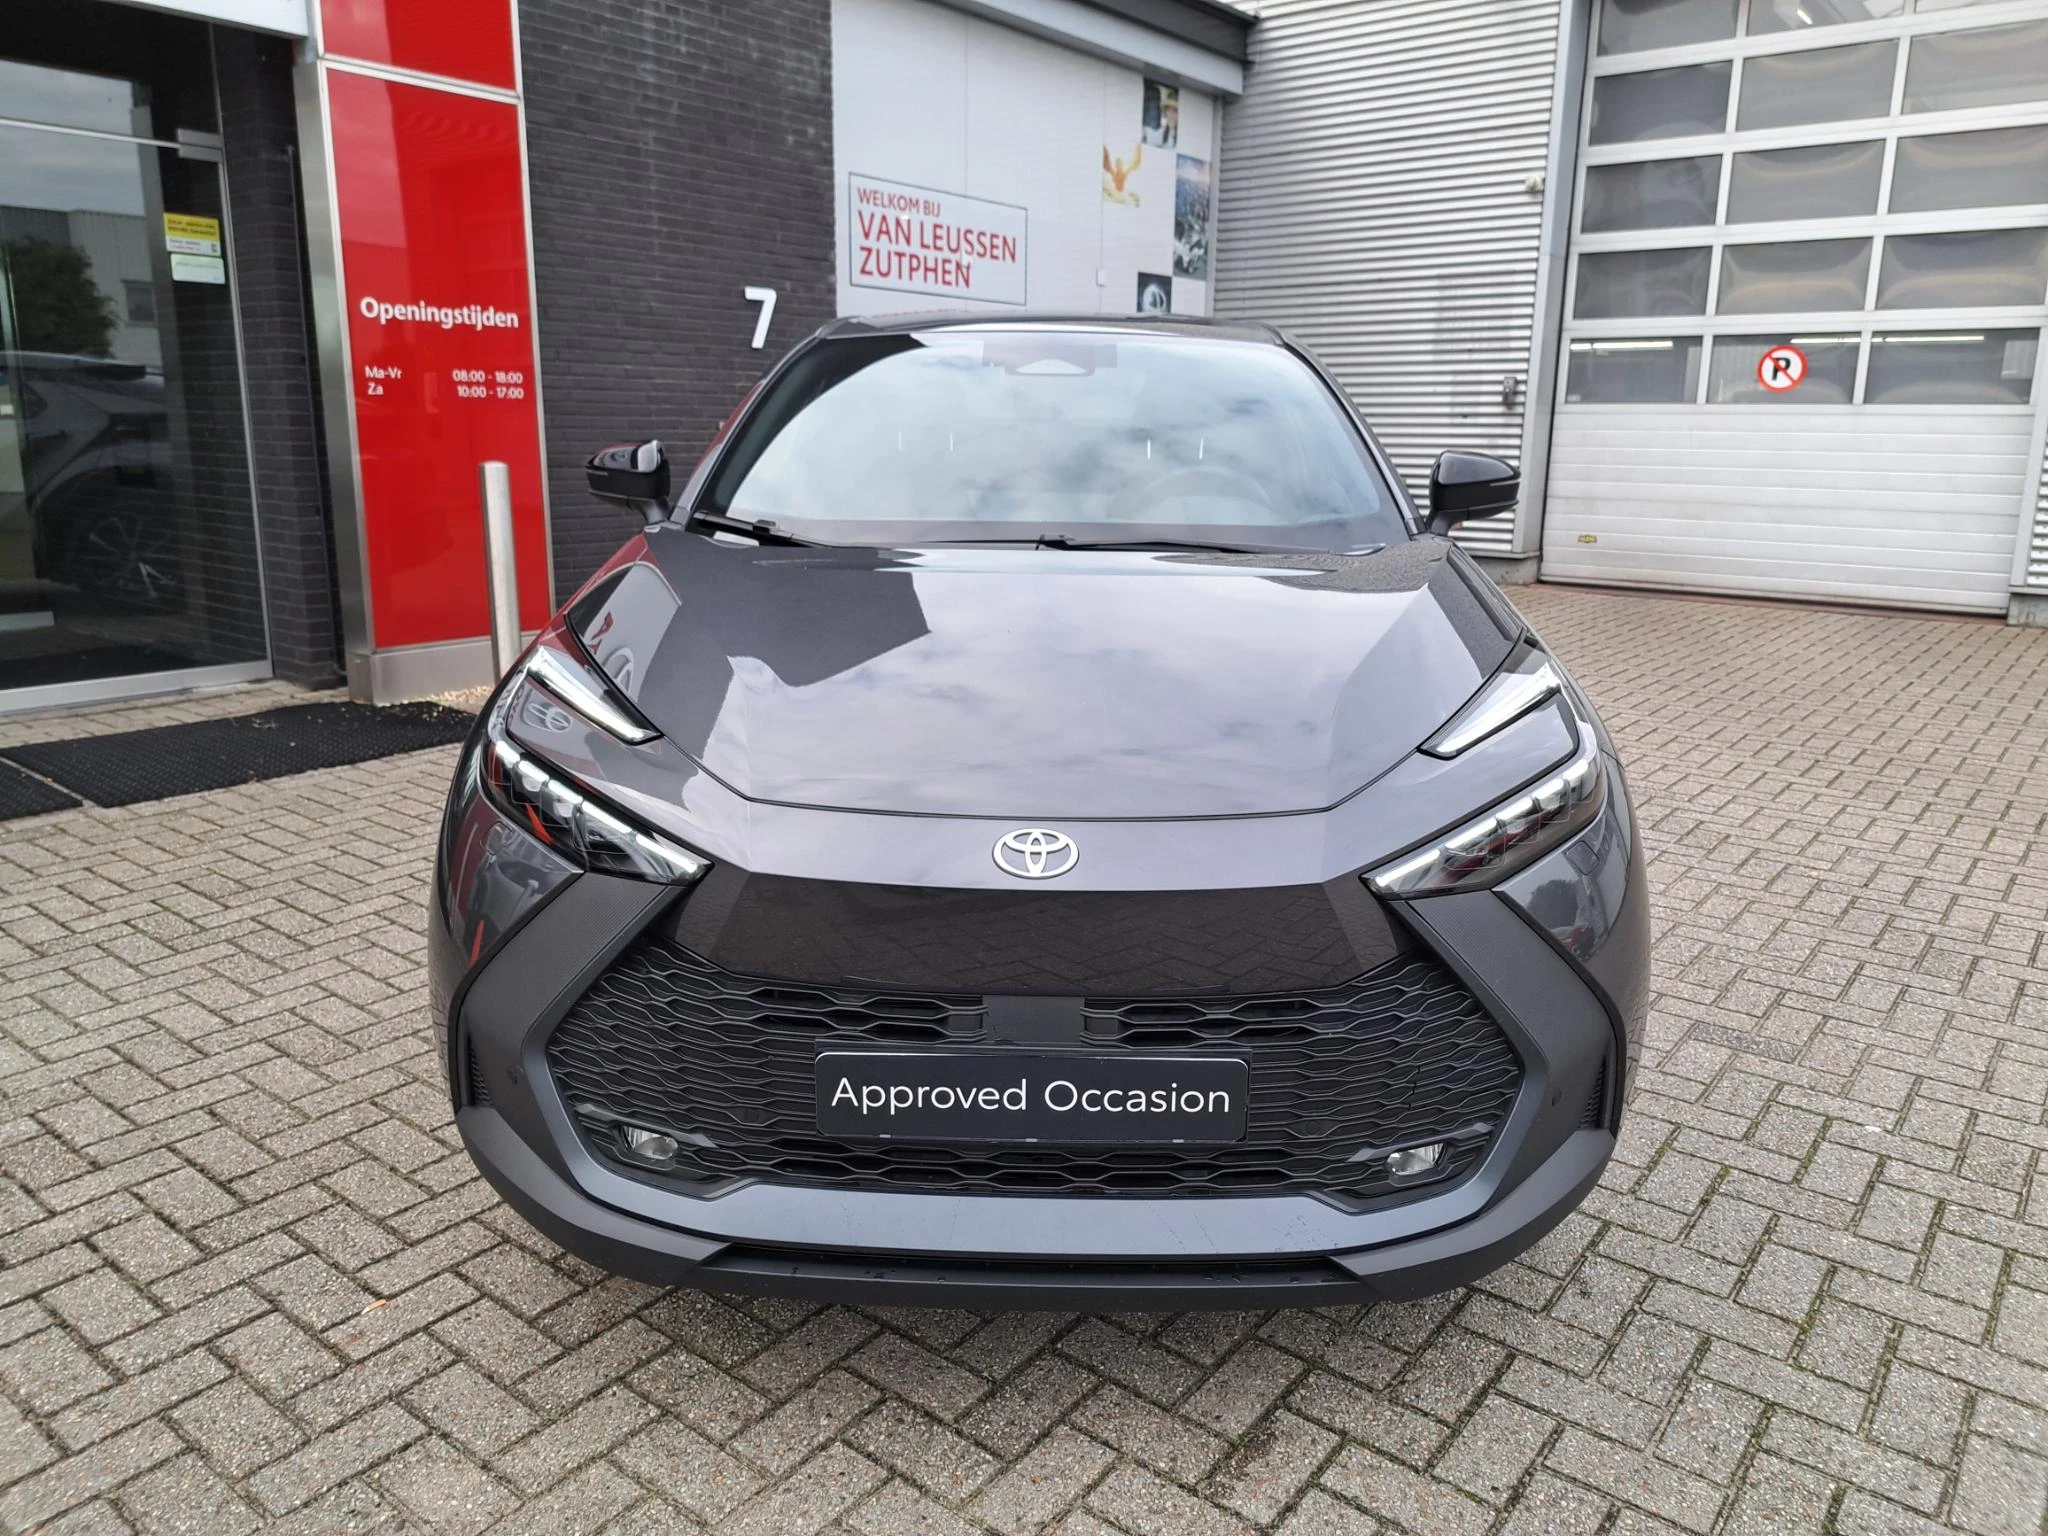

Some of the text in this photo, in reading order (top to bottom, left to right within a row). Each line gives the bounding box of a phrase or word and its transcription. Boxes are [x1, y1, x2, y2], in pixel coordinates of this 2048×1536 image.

[857, 187, 941, 218] WELKOM BIJ
[858, 209, 1017, 264] VAN LEUSSEN
[859, 246, 971, 289] ZUTPHEN
[360, 296, 519, 331] Openingstijden
[744, 286, 777, 349] 7
[364, 365, 402, 379] Ma-Vr
[452, 368, 486, 383] 08:00
[495, 370, 523, 384] 18:00
[367, 382, 384, 396] Za
[457, 385, 487, 398] 10:00
[496, 386, 525, 399] 17:00
[831, 1077, 1230, 1116] Approved Occasion
